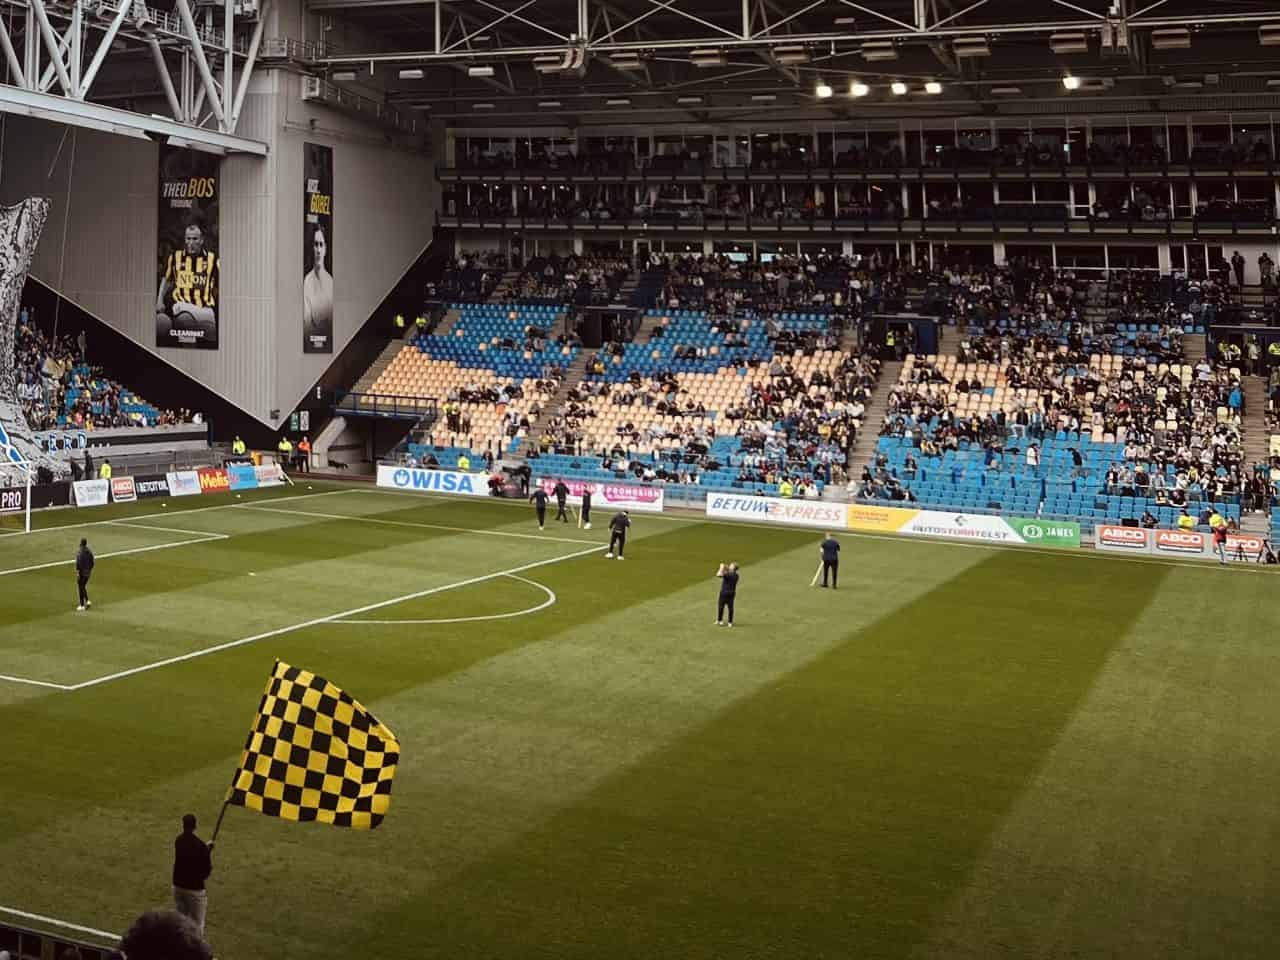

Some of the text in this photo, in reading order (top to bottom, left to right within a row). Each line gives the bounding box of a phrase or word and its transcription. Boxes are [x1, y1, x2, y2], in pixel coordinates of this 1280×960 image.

[163, 177, 215, 198] THEO BOS
[412, 470, 474, 493] WISA
[2, 491, 22, 507] PRO
